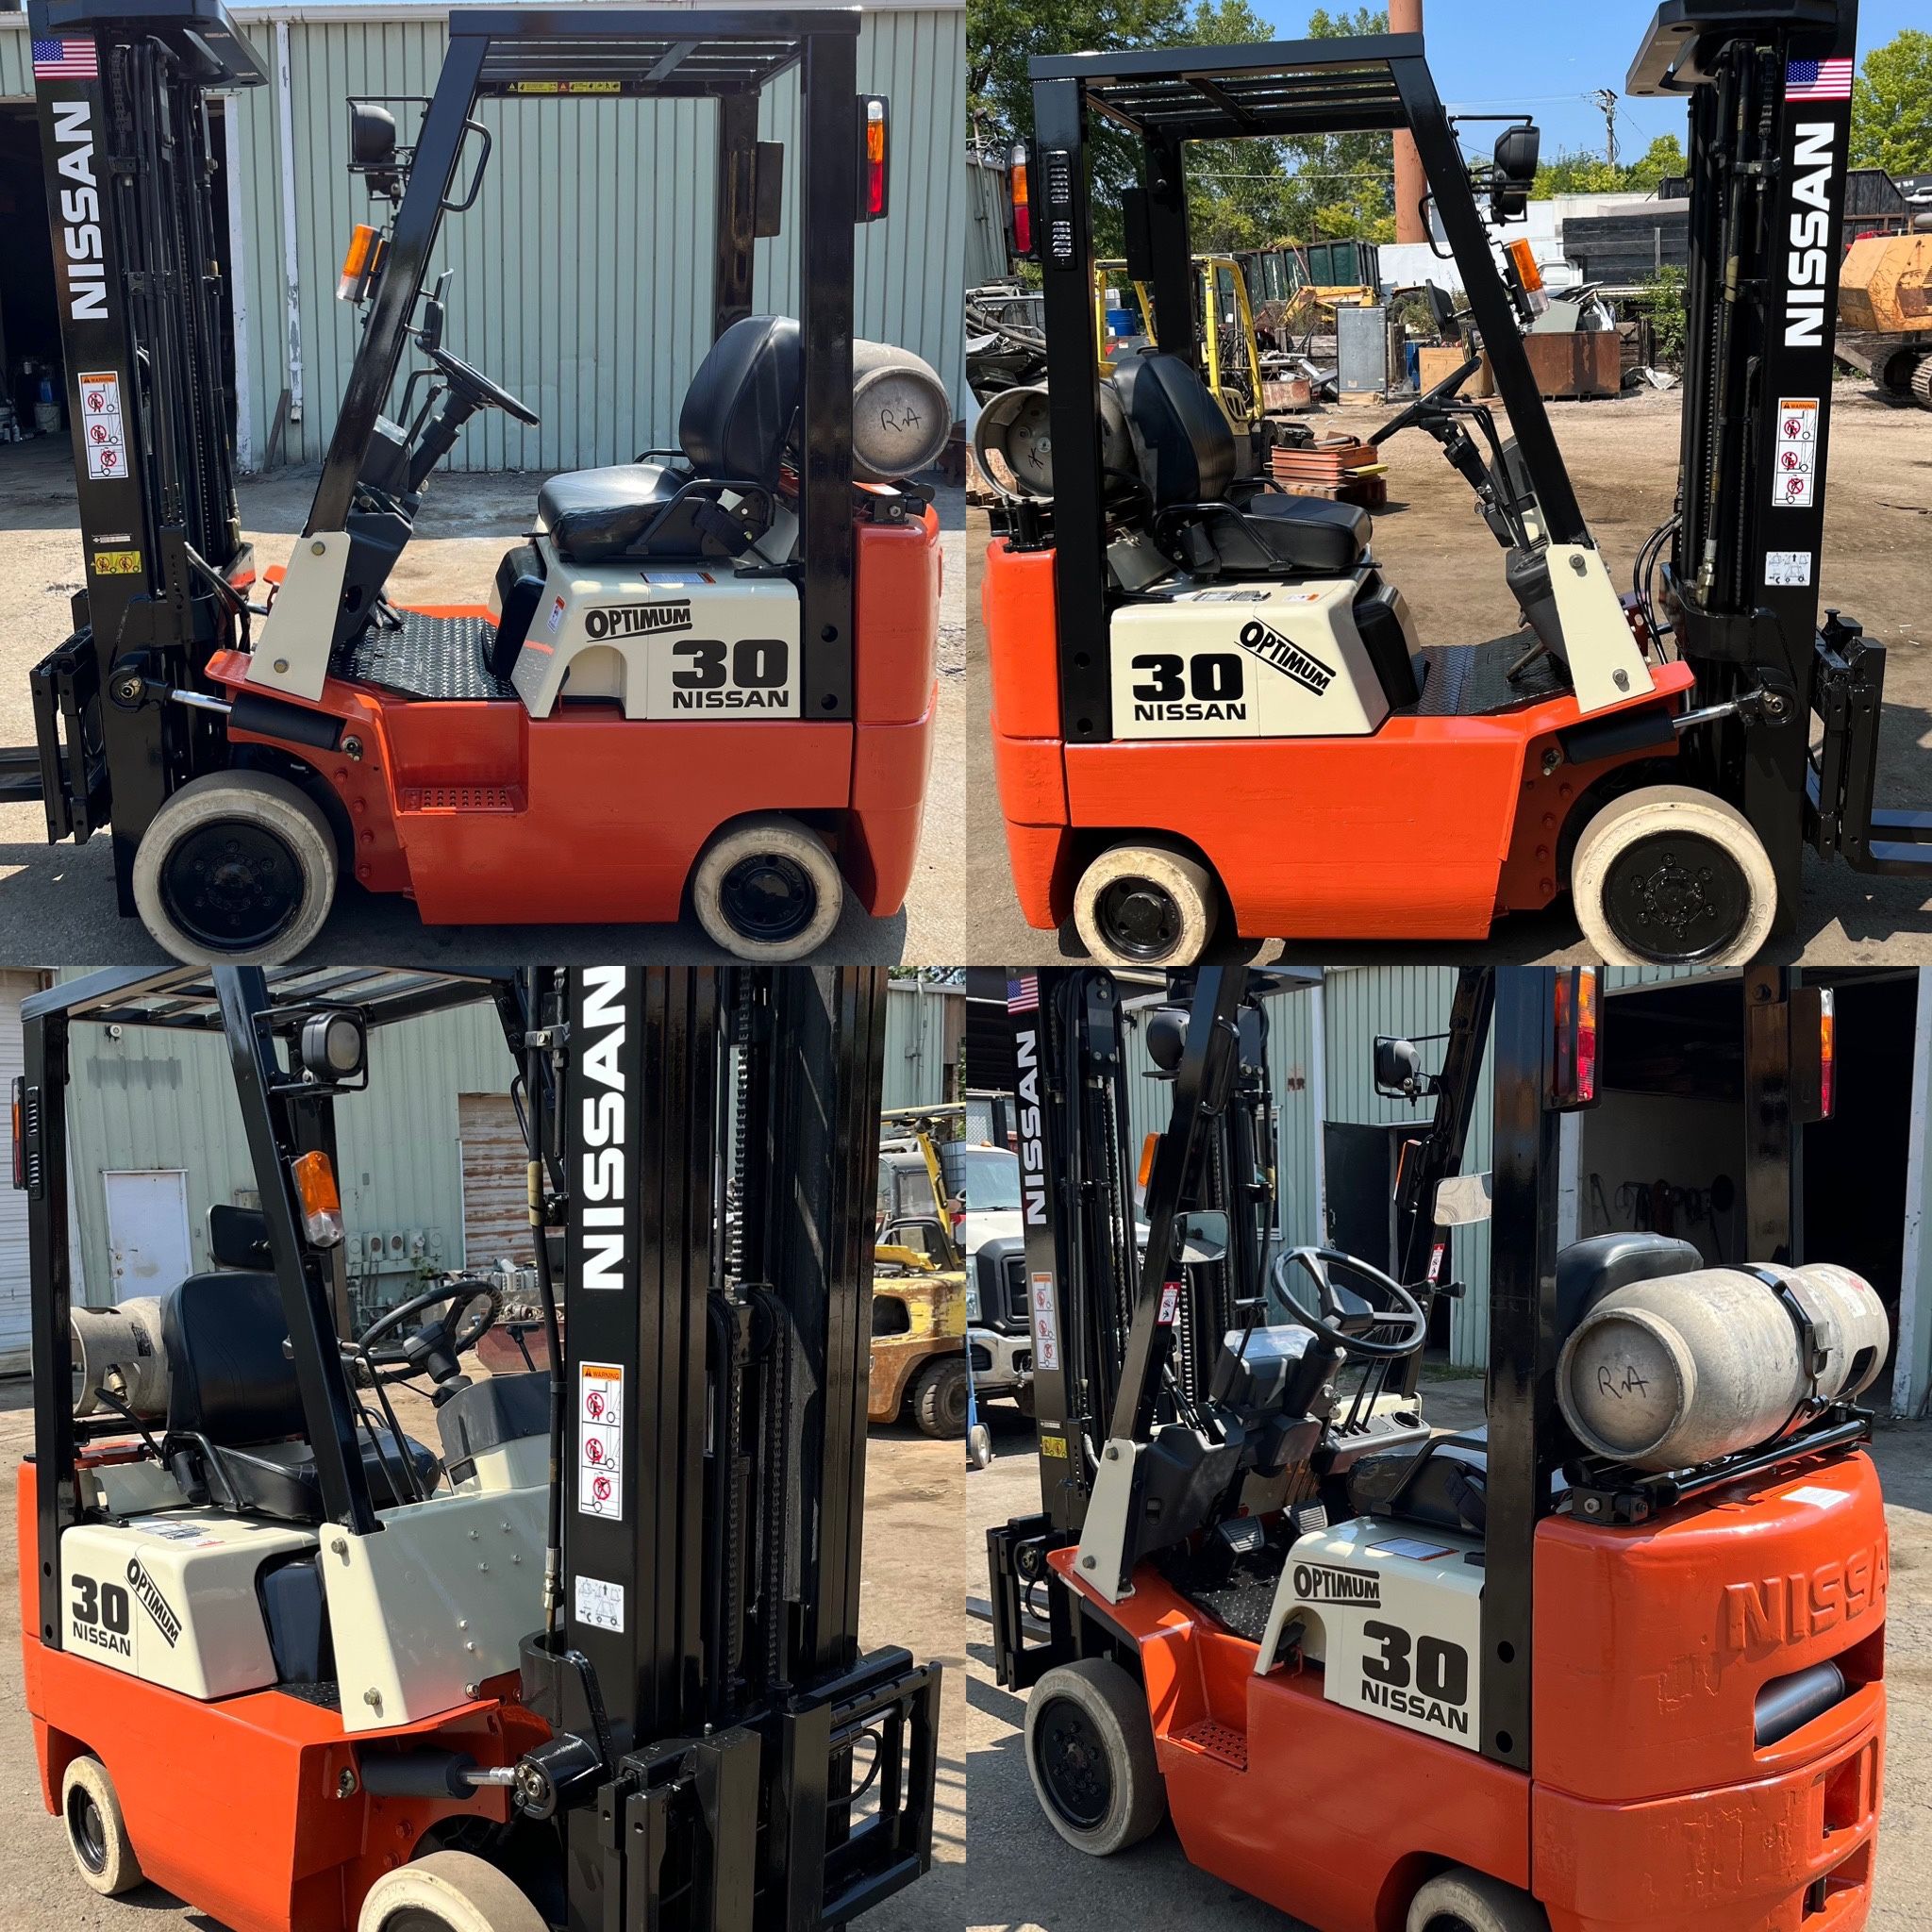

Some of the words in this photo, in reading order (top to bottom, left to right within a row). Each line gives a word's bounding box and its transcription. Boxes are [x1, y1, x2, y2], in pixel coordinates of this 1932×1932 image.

[53, 102, 108, 320] NISSAN
[1785, 123, 1835, 347] NISSAN
[586, 608, 691, 639] OPTIMUM
[673, 640, 789, 689] 30
[1132, 654, 1244, 701] 30
[1241, 621, 1330, 691] OPTIMUM
[673, 691, 789, 709] NISSAN
[1134, 703, 1246, 722] NISSAN
[583, 966, 626, 1290] NISSAN
[1016, 1029, 1047, 1225] NISSAN
[592, 1371, 620, 1380] WARNING
[72, 1574, 129, 1636] 30
[127, 1558, 181, 1643] OPTIMUM
[1293, 1564, 1380, 1599] OPTIMUM
[73, 1621, 131, 1657] NISSAN
[1362, 1620, 1469, 1707] 30
[1361, 1679, 1469, 1735] NISSAN
